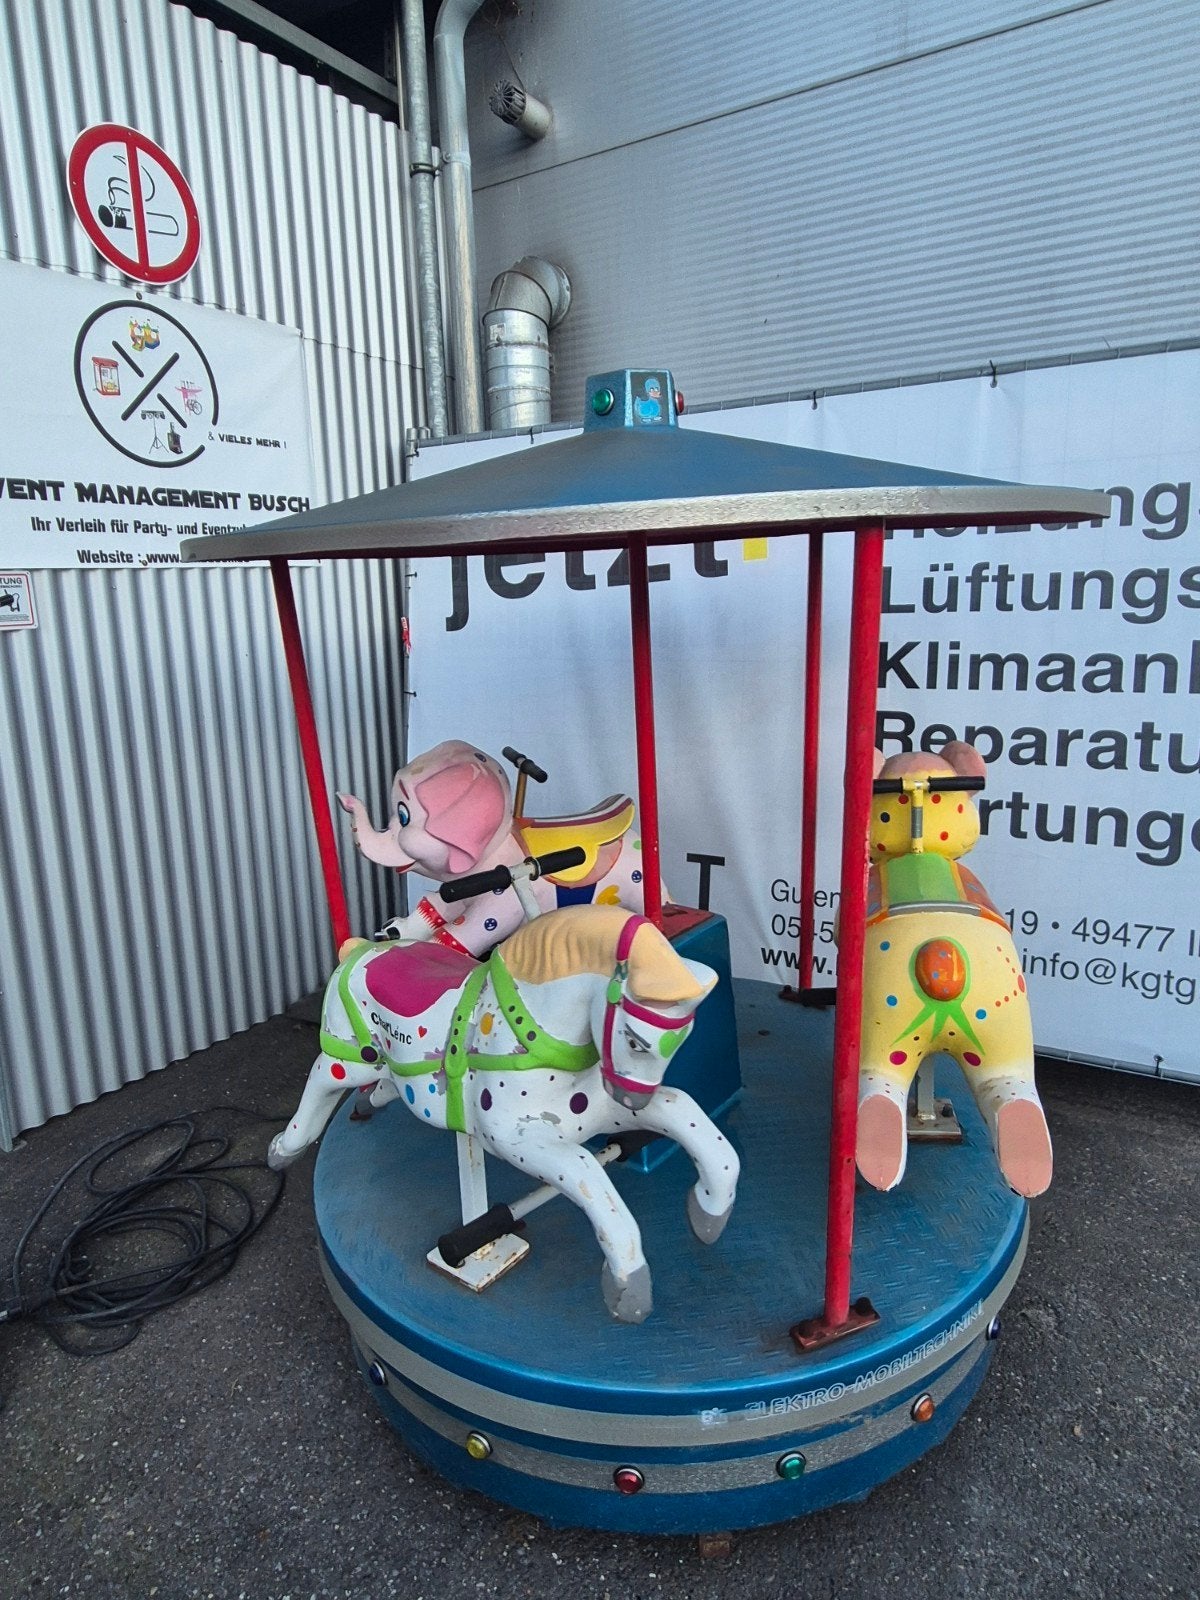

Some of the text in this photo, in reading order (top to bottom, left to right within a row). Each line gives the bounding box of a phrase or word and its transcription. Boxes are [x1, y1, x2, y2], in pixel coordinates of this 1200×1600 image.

[207, 431, 215, 442] &
[218, 434, 252, 446] VIELES
[256, 437, 281, 449] MEHR
[74, 482, 241, 510] MANAGEMENT
[248, 493, 310, 513] BUSCH
[31, 516, 51, 532] Ihr
[56, 517, 106, 533] Verleih
[111, 519, 129, 533] für
[133, 520, 172, 537] Party-
[177, 522, 198, 535] und
[77, 549, 134, 564] Website
[1071, 917, 1175, 952] 49477
[1022, 948, 1196, 1005] info@kgtg
